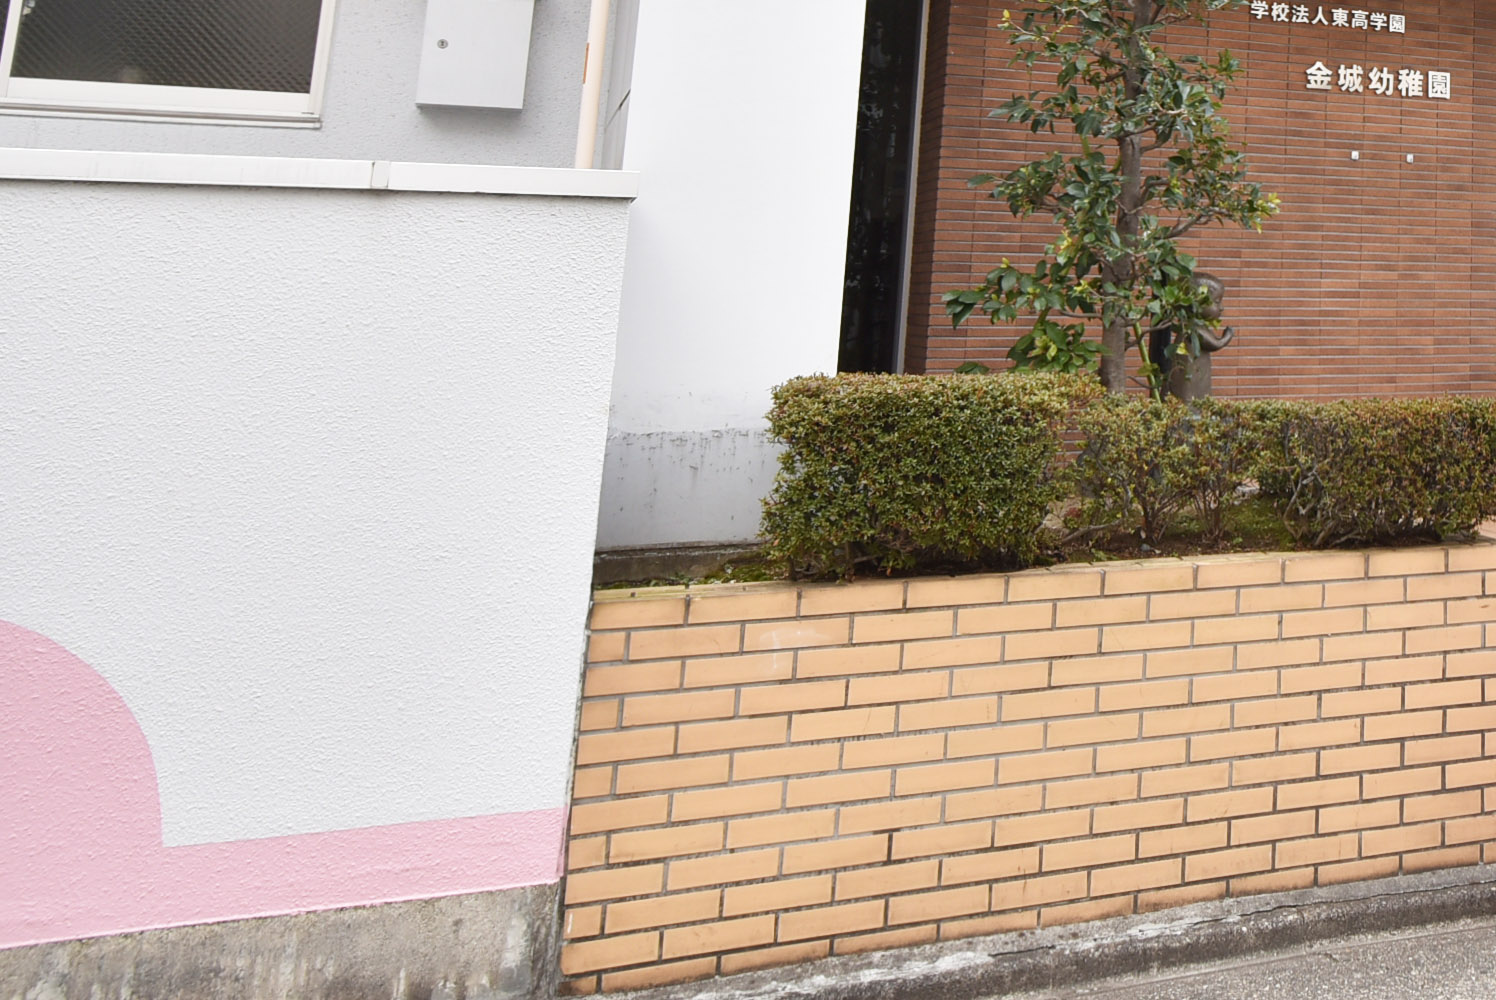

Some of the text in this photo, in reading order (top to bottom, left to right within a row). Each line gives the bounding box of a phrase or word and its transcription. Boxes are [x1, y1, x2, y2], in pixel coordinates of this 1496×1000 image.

[1250, 0, 1406, 34] 学校法人東高学園
[1306, 61, 1451, 100] 金城幼稚園
